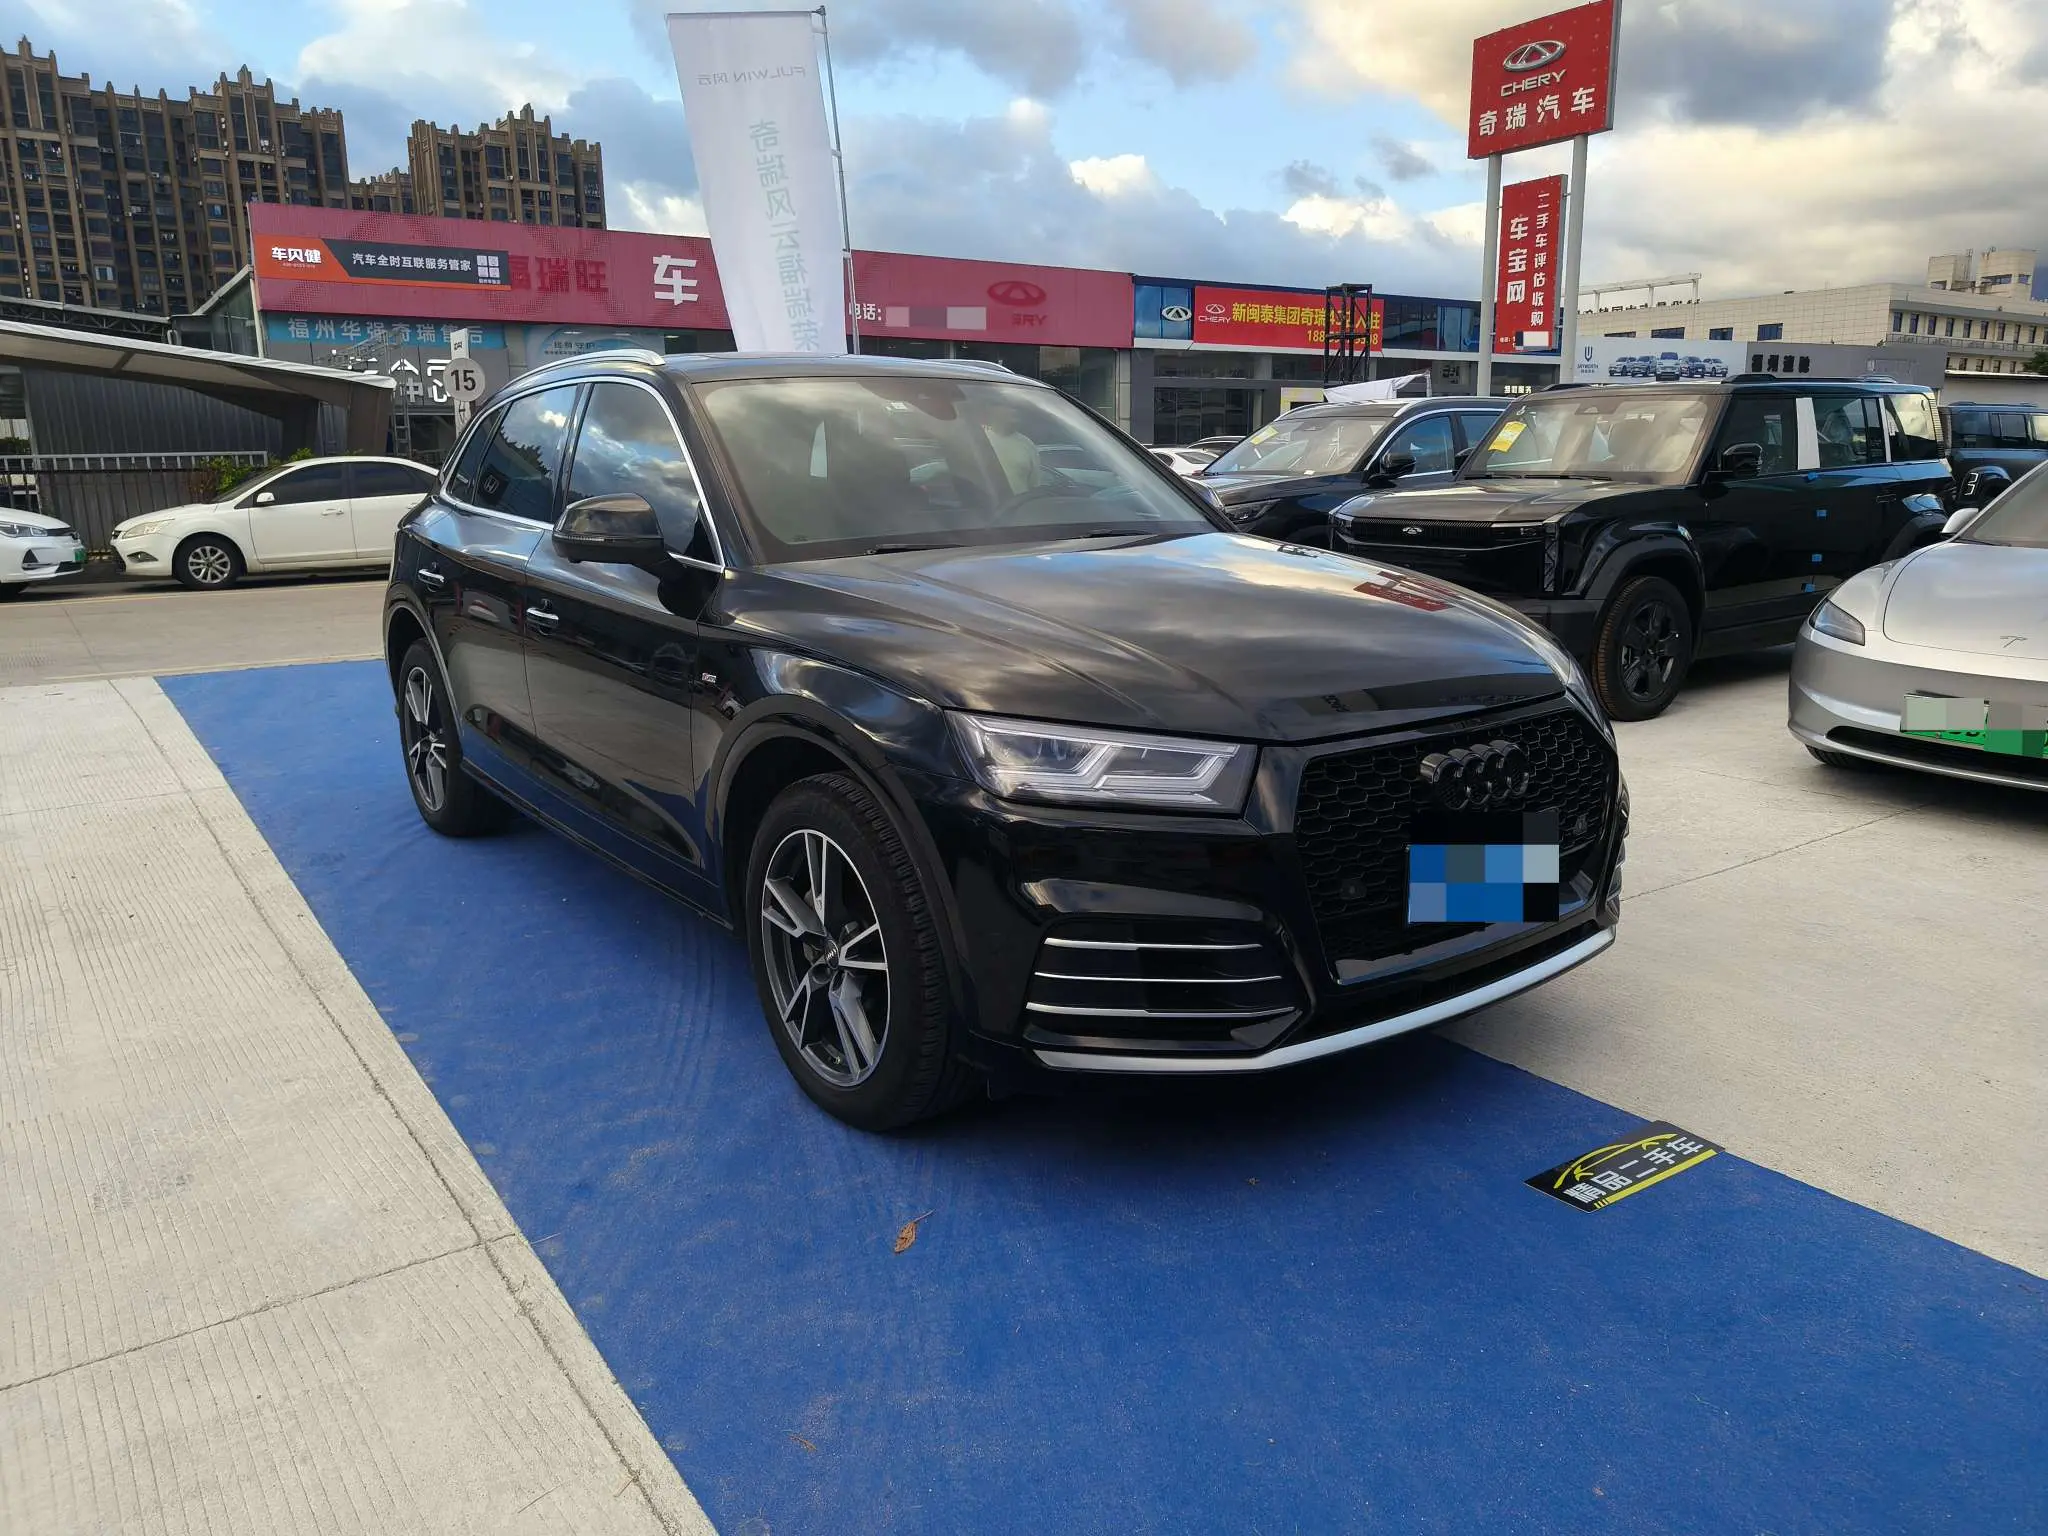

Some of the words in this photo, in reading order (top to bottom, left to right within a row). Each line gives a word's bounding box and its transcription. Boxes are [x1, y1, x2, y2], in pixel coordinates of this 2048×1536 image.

[1500, 69, 1566, 97] CHERY
[1478, 87, 1595, 136] 奇瑞汽车
[271, 246, 322, 264] 车贝健
[352, 253, 472, 272] 汽车全时互联服务管家
[1506, 215, 1529, 304] 车宝网
[1530, 192, 1550, 327] 二手车评估收购
[652, 254, 699, 306] 车
[1198, 315, 1231, 323] CHERY
[451, 369, 477, 391] 15
[1563, 1136, 1704, 1204] 精品二手车
